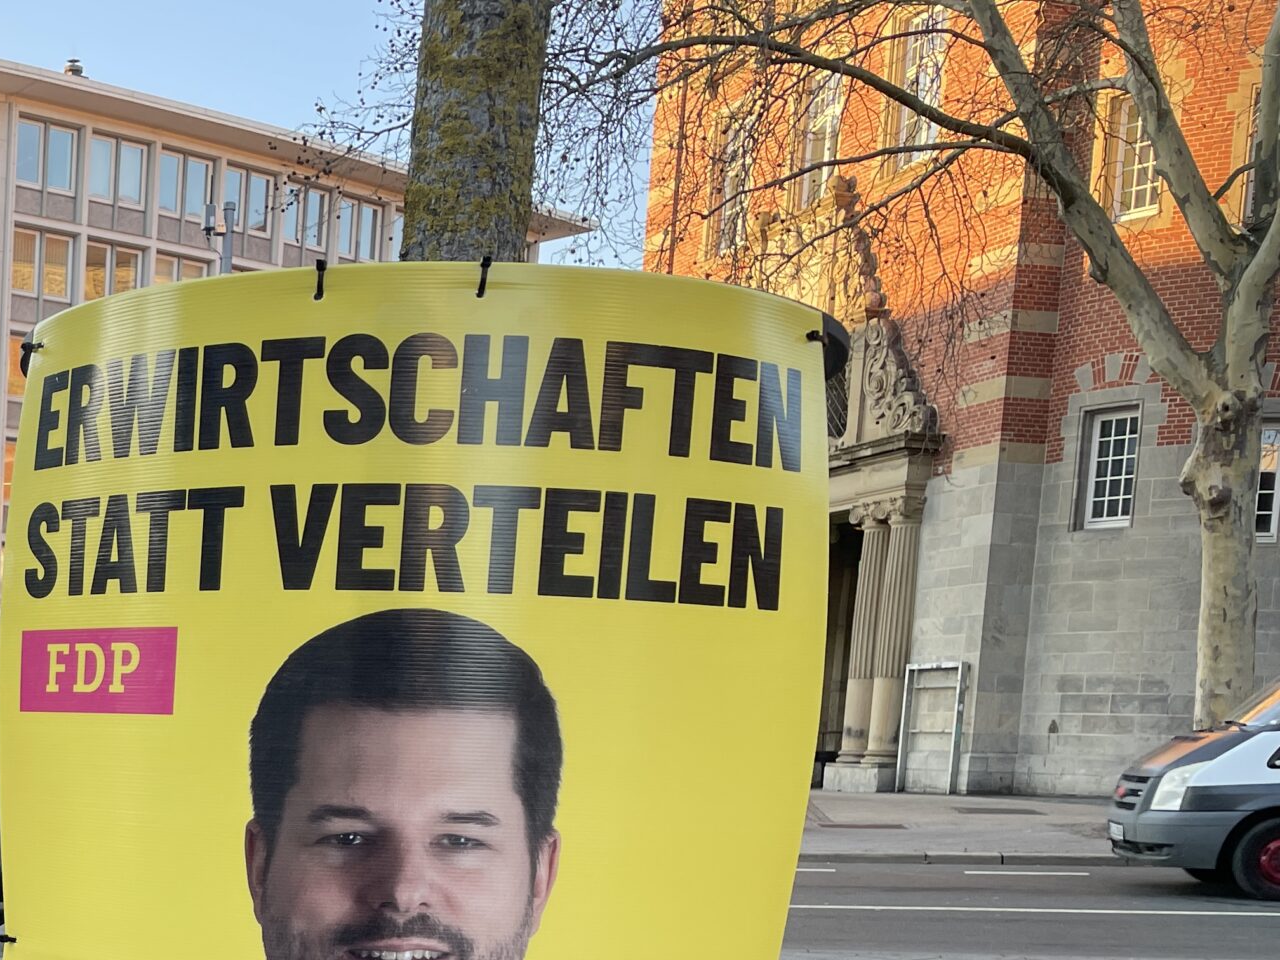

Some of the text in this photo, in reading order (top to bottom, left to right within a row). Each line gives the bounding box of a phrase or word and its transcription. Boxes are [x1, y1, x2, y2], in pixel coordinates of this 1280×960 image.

[33, 332, 802, 473] ERWIRTSCHAFTEN
[24, 483, 784, 611] STATT VERTEILEN
[45, 642, 141, 694] FDP
